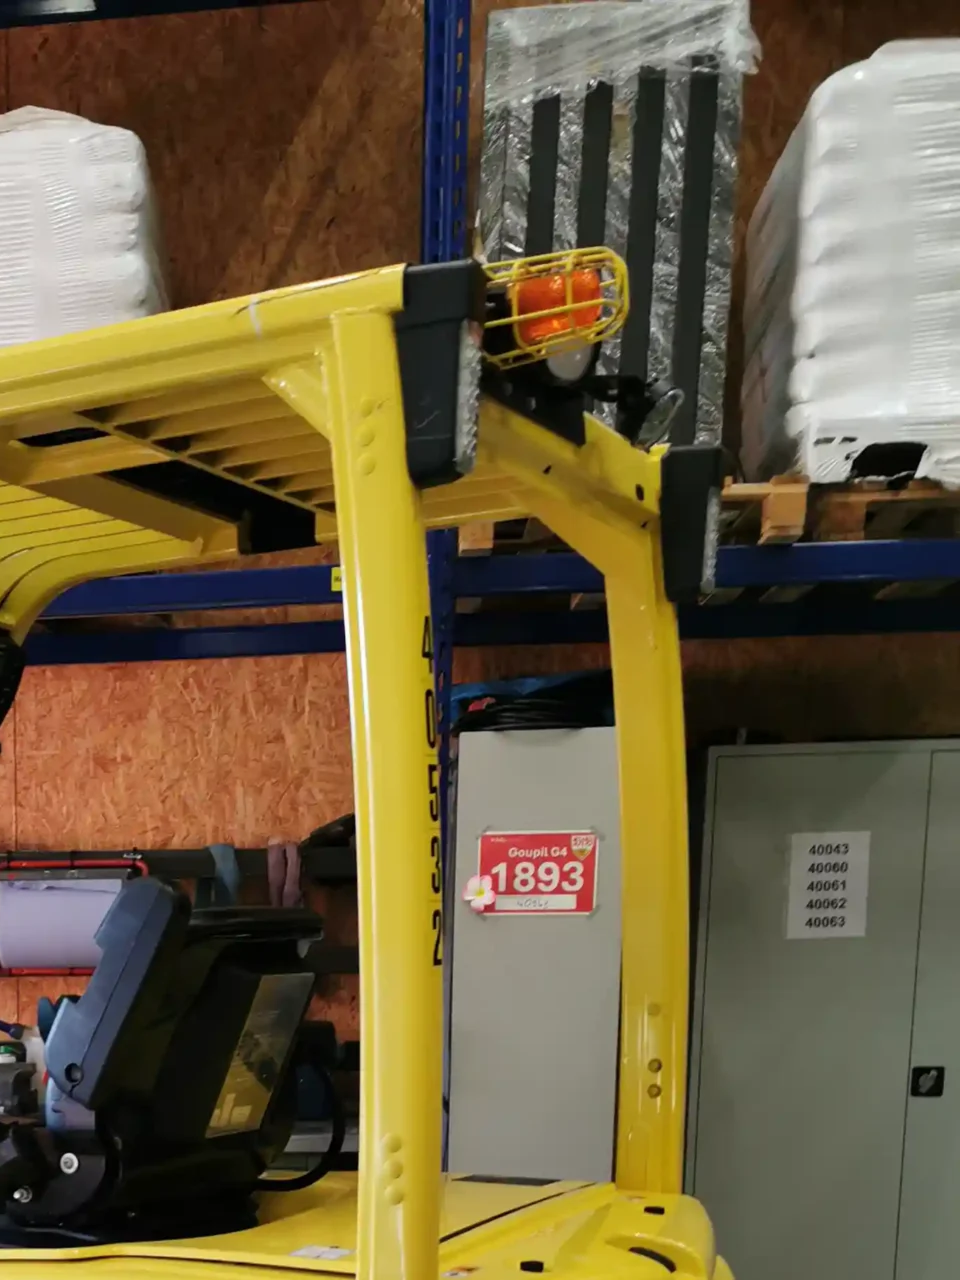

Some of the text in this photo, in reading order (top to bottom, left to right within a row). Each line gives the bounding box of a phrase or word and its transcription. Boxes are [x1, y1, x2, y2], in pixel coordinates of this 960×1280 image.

[508, 847, 568, 860] Goupil G4
[808, 843, 849, 856] 40043
[807, 861, 849, 874] 40060
[490, 861, 585, 893] 1893
[806, 880, 847, 892] 40061
[805, 898, 848, 910] 40062
[804, 916, 846, 929] 40063
